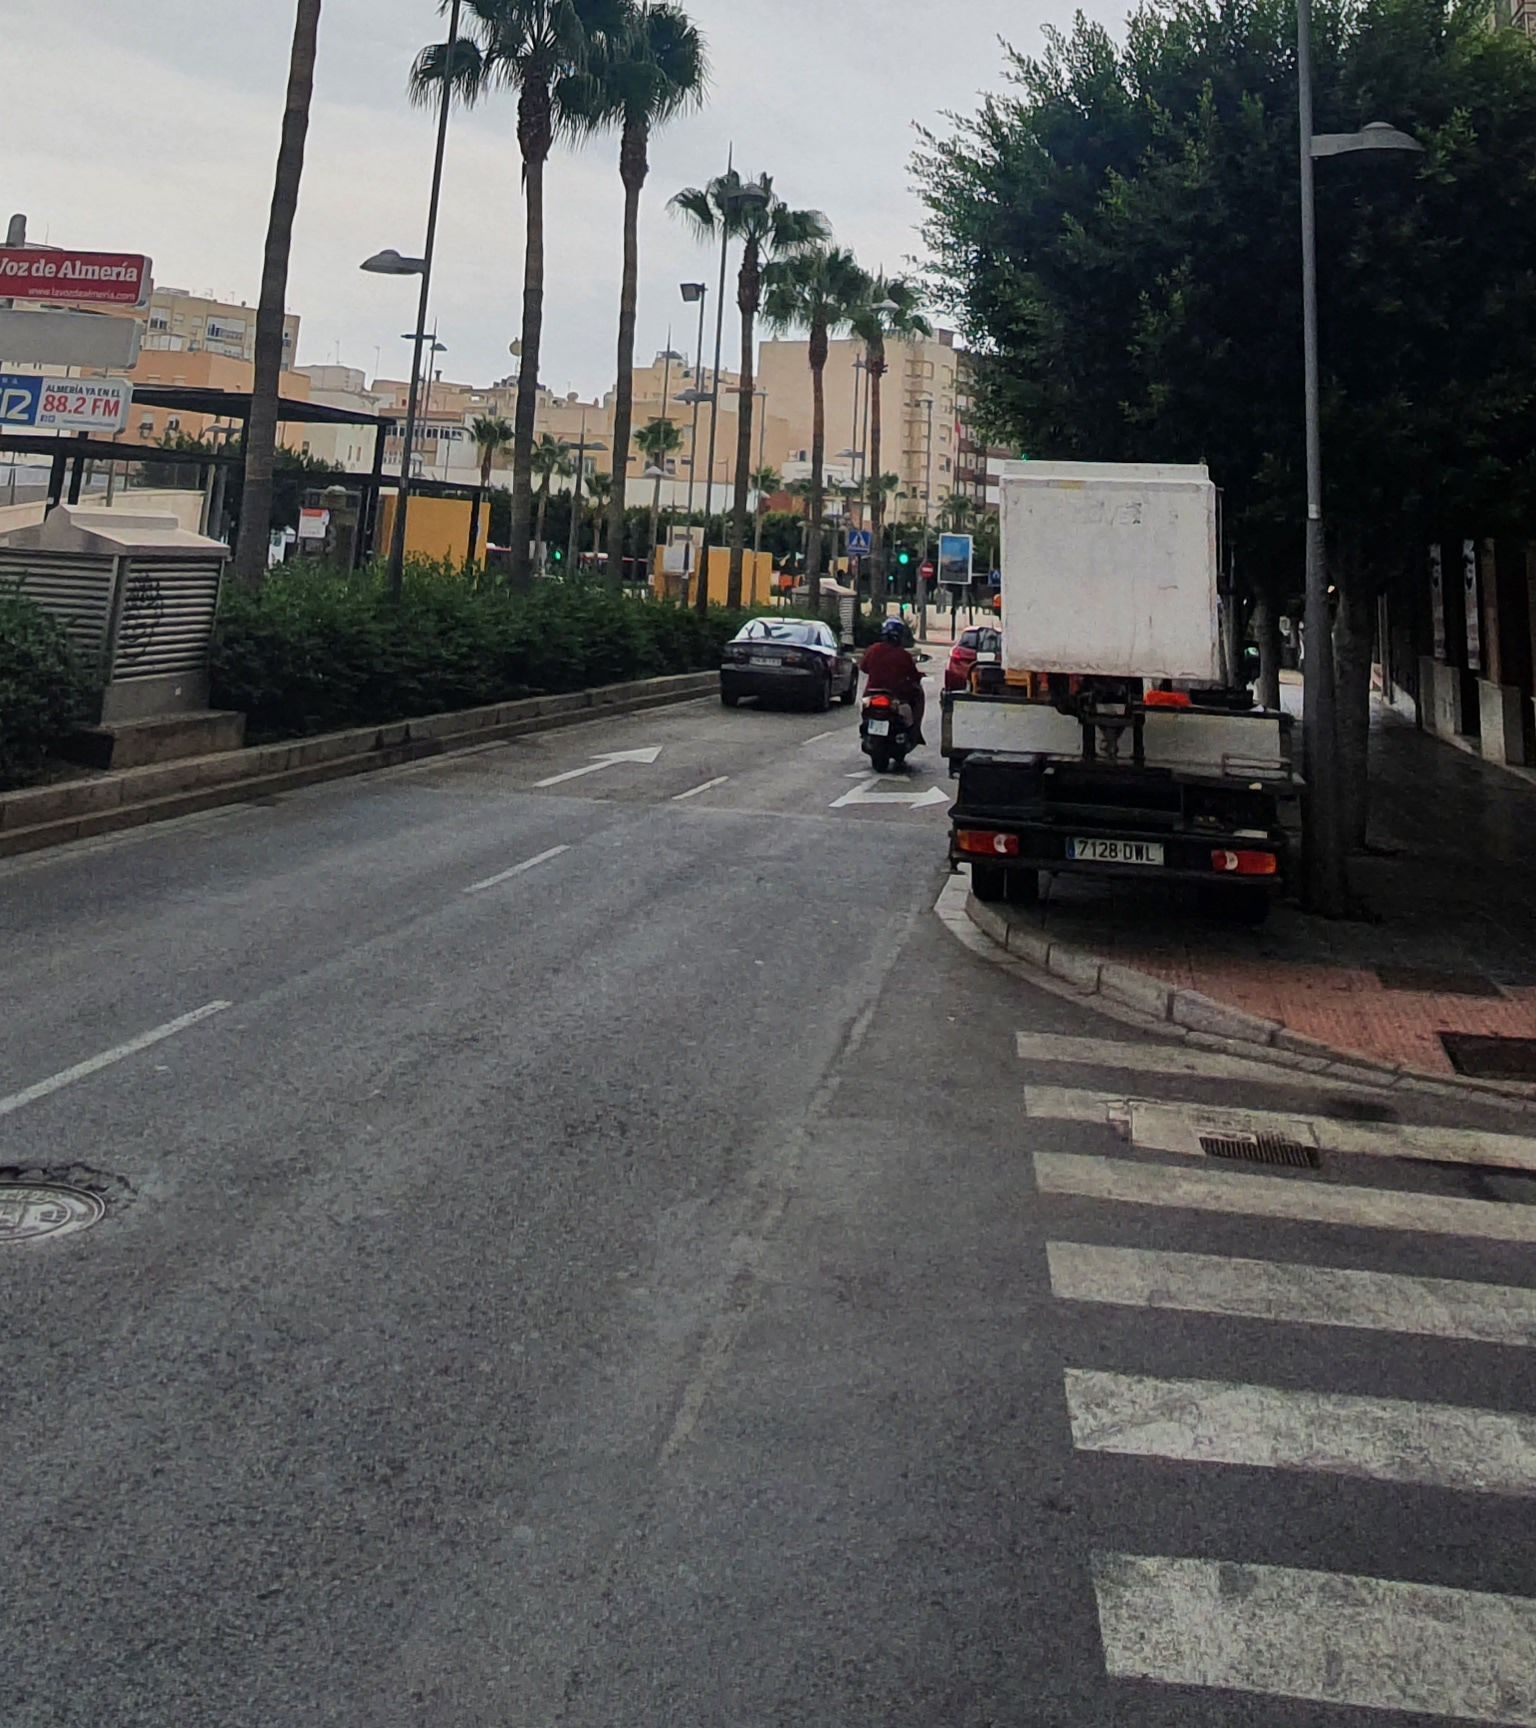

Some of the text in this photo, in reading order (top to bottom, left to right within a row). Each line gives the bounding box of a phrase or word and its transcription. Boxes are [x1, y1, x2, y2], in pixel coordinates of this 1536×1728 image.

[31, 259, 56, 278] de
[57, 260, 138, 282] Almería
[85, 386, 96, 396] YA
[97, 387, 110, 397] EN
[42, 394, 121, 417] 88.2 FM
[1078, 839, 1156, 862] 7128 DWL
